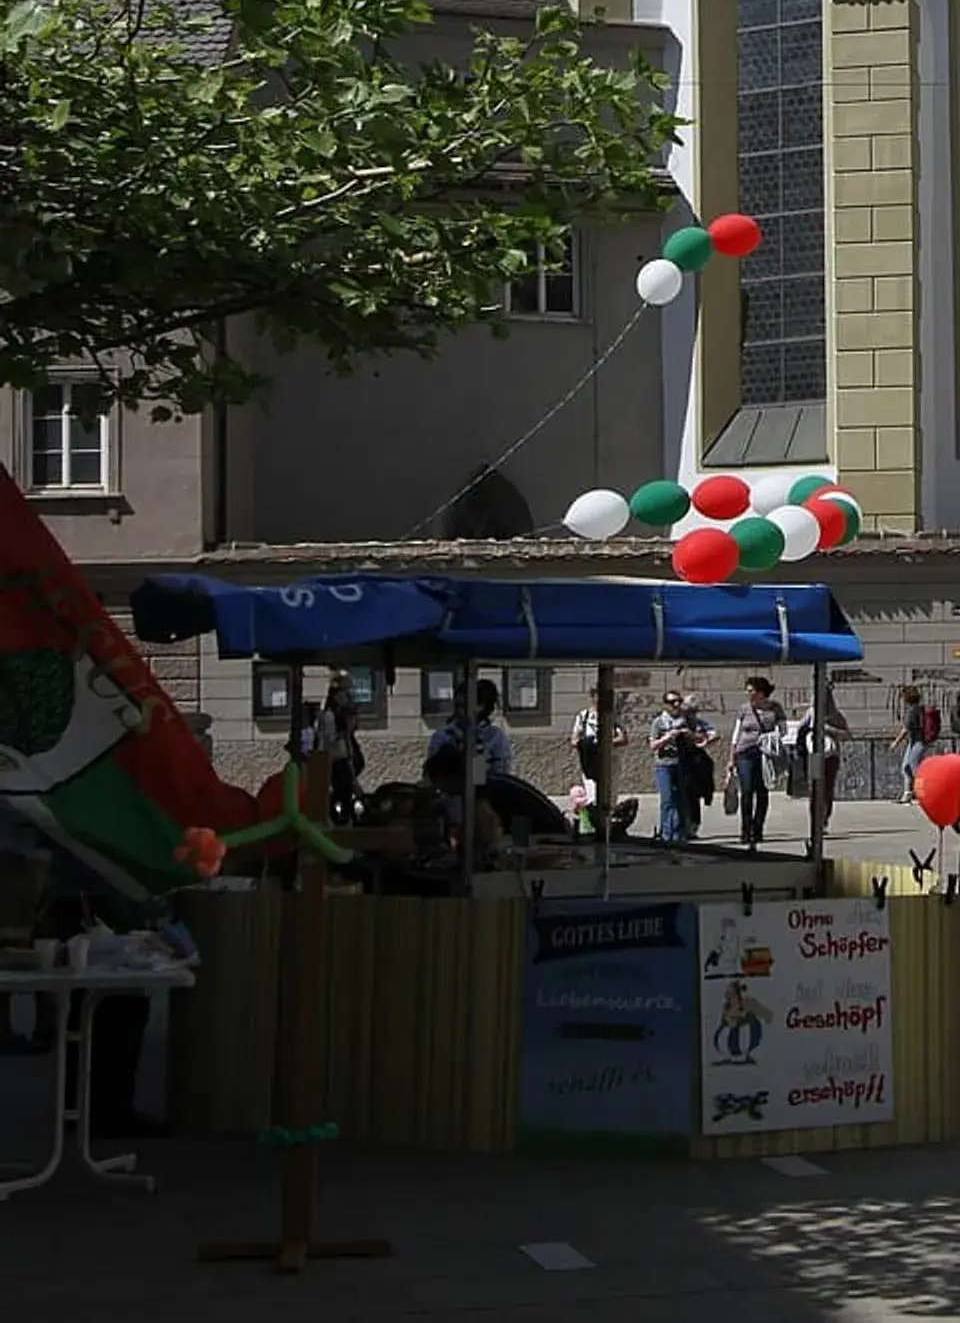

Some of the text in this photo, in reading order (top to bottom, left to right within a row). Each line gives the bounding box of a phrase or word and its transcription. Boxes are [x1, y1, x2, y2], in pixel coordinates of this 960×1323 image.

[550, 916, 665, 949] GOTTES LIEBE
[799, 932, 889, 960] Schöpfer
[786, 995, 888, 1034] Geschöpf
